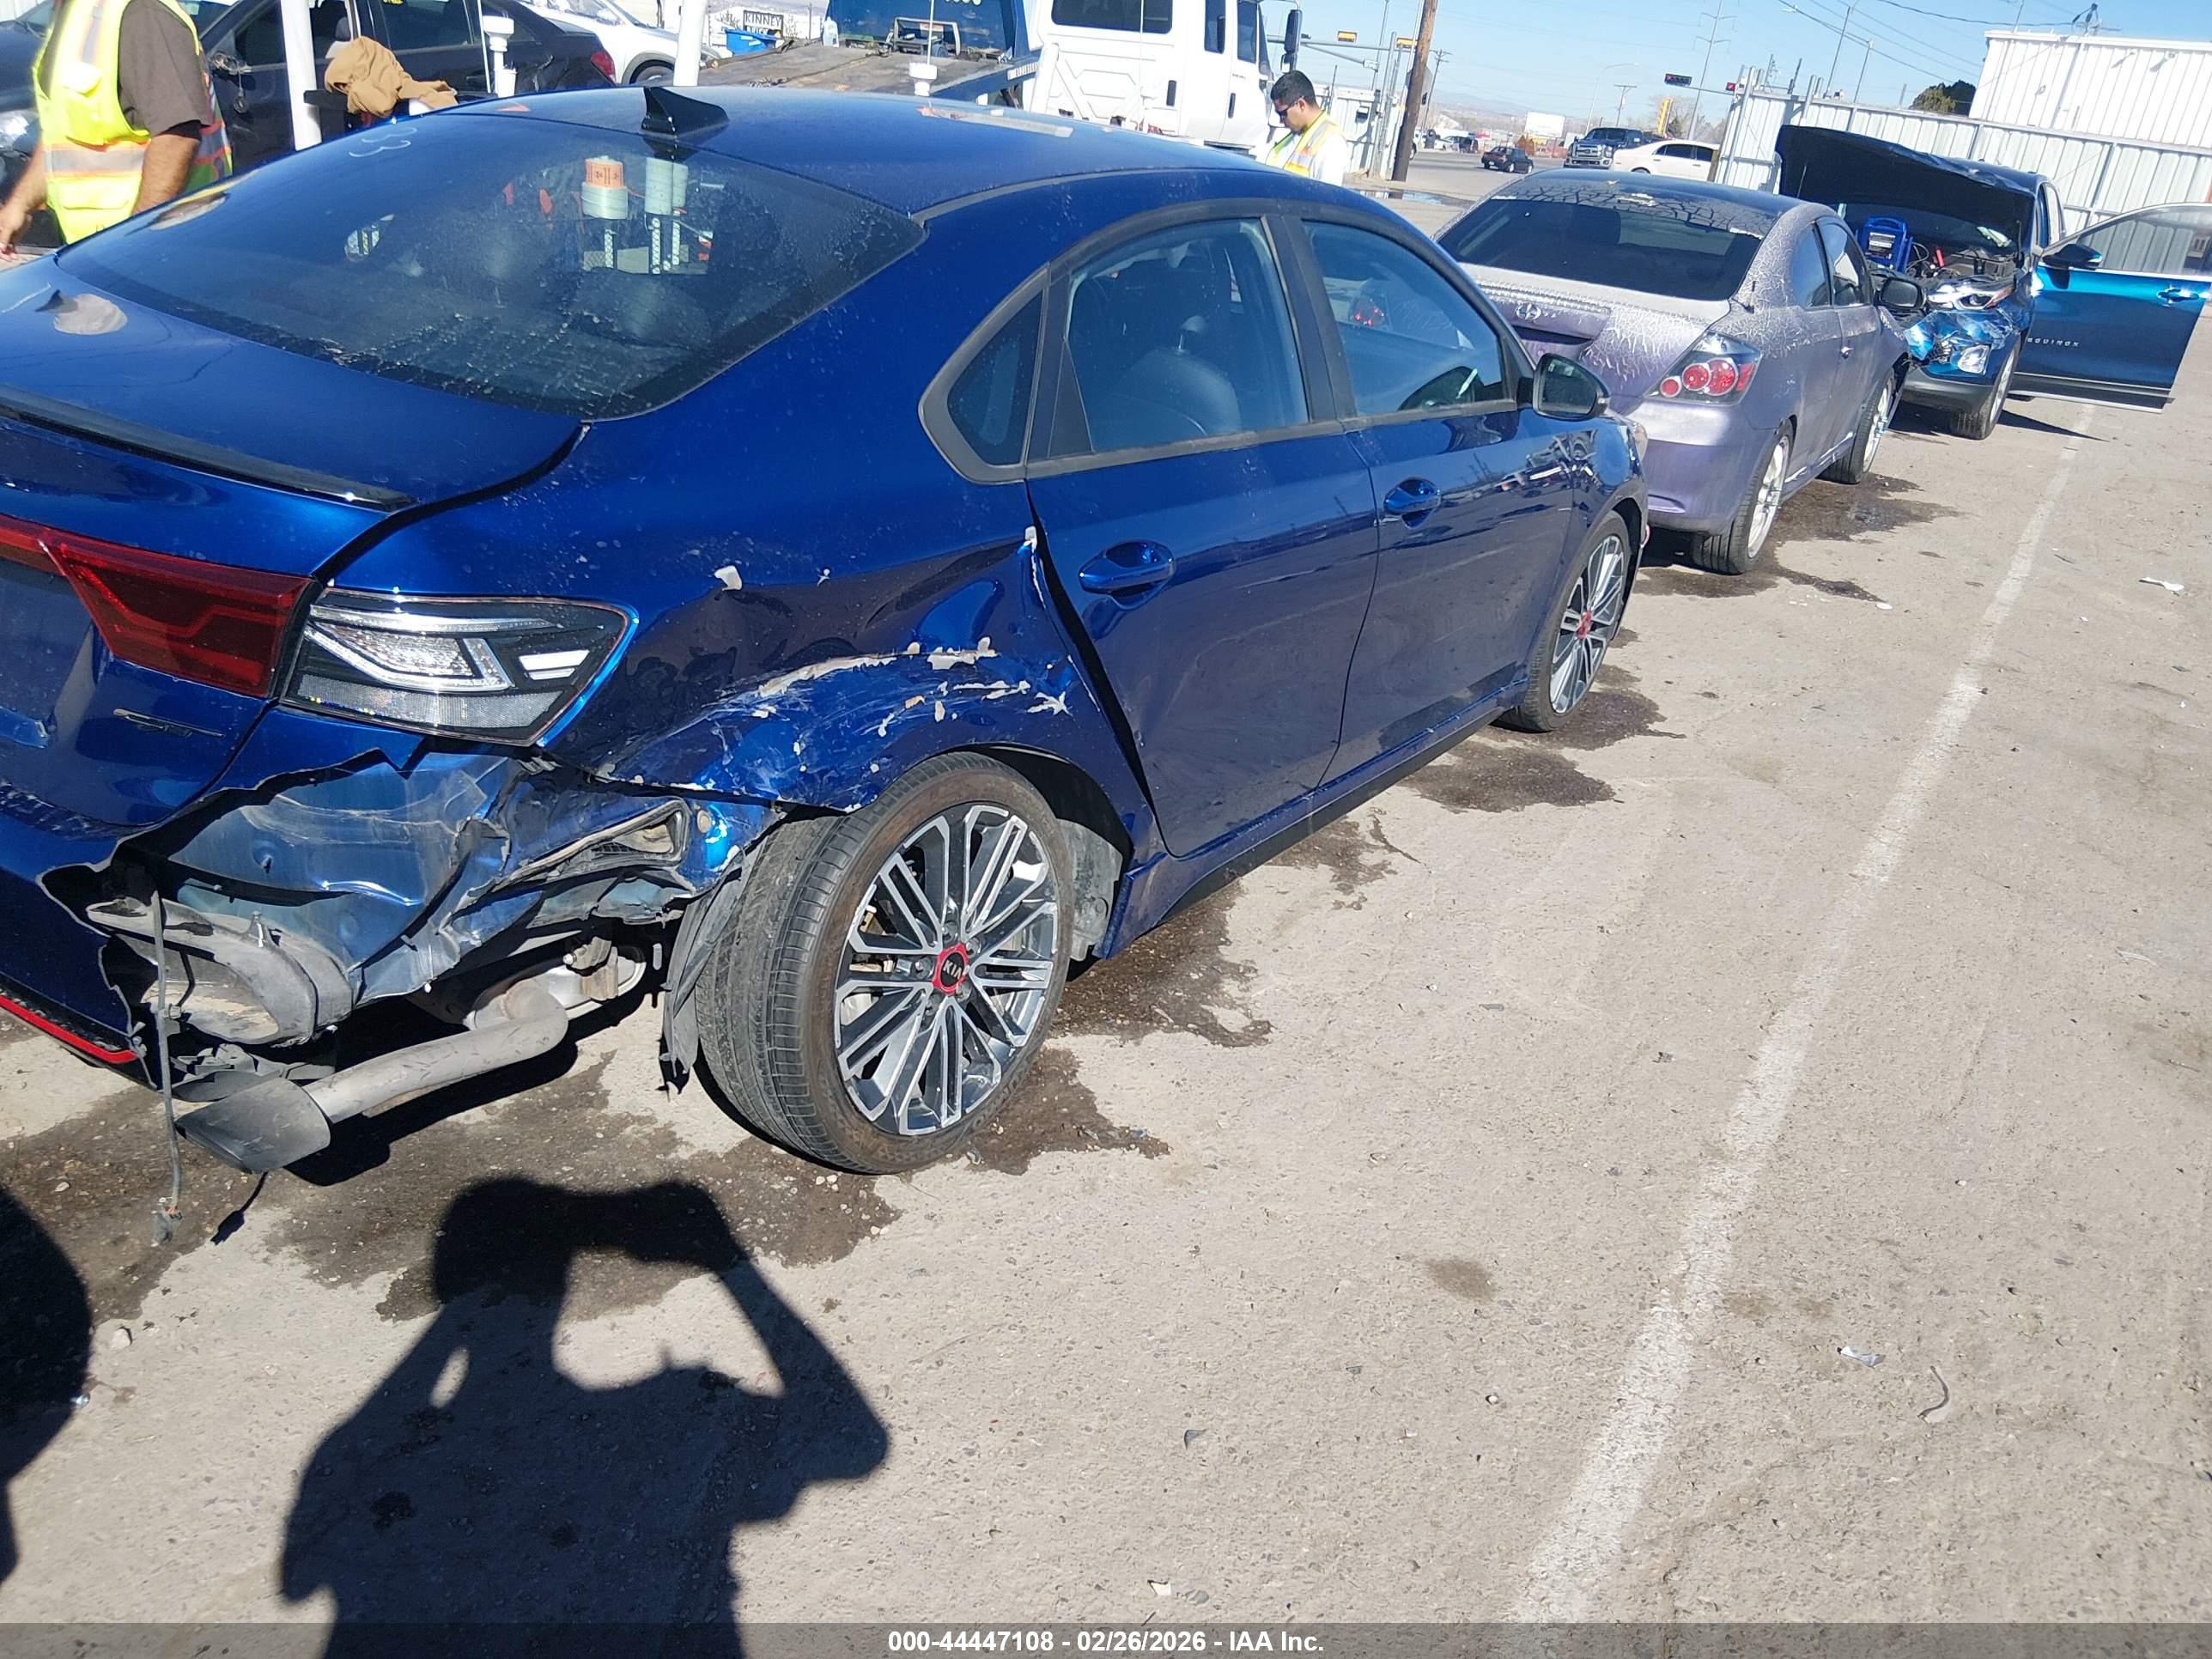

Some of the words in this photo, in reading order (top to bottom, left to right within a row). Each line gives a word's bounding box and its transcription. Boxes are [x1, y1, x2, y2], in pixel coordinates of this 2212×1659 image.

[745, 12, 782, 27] KINNEY
[2026, 337, 2081, 347] EQUINOX
[942, 959, 963, 981] KIA
